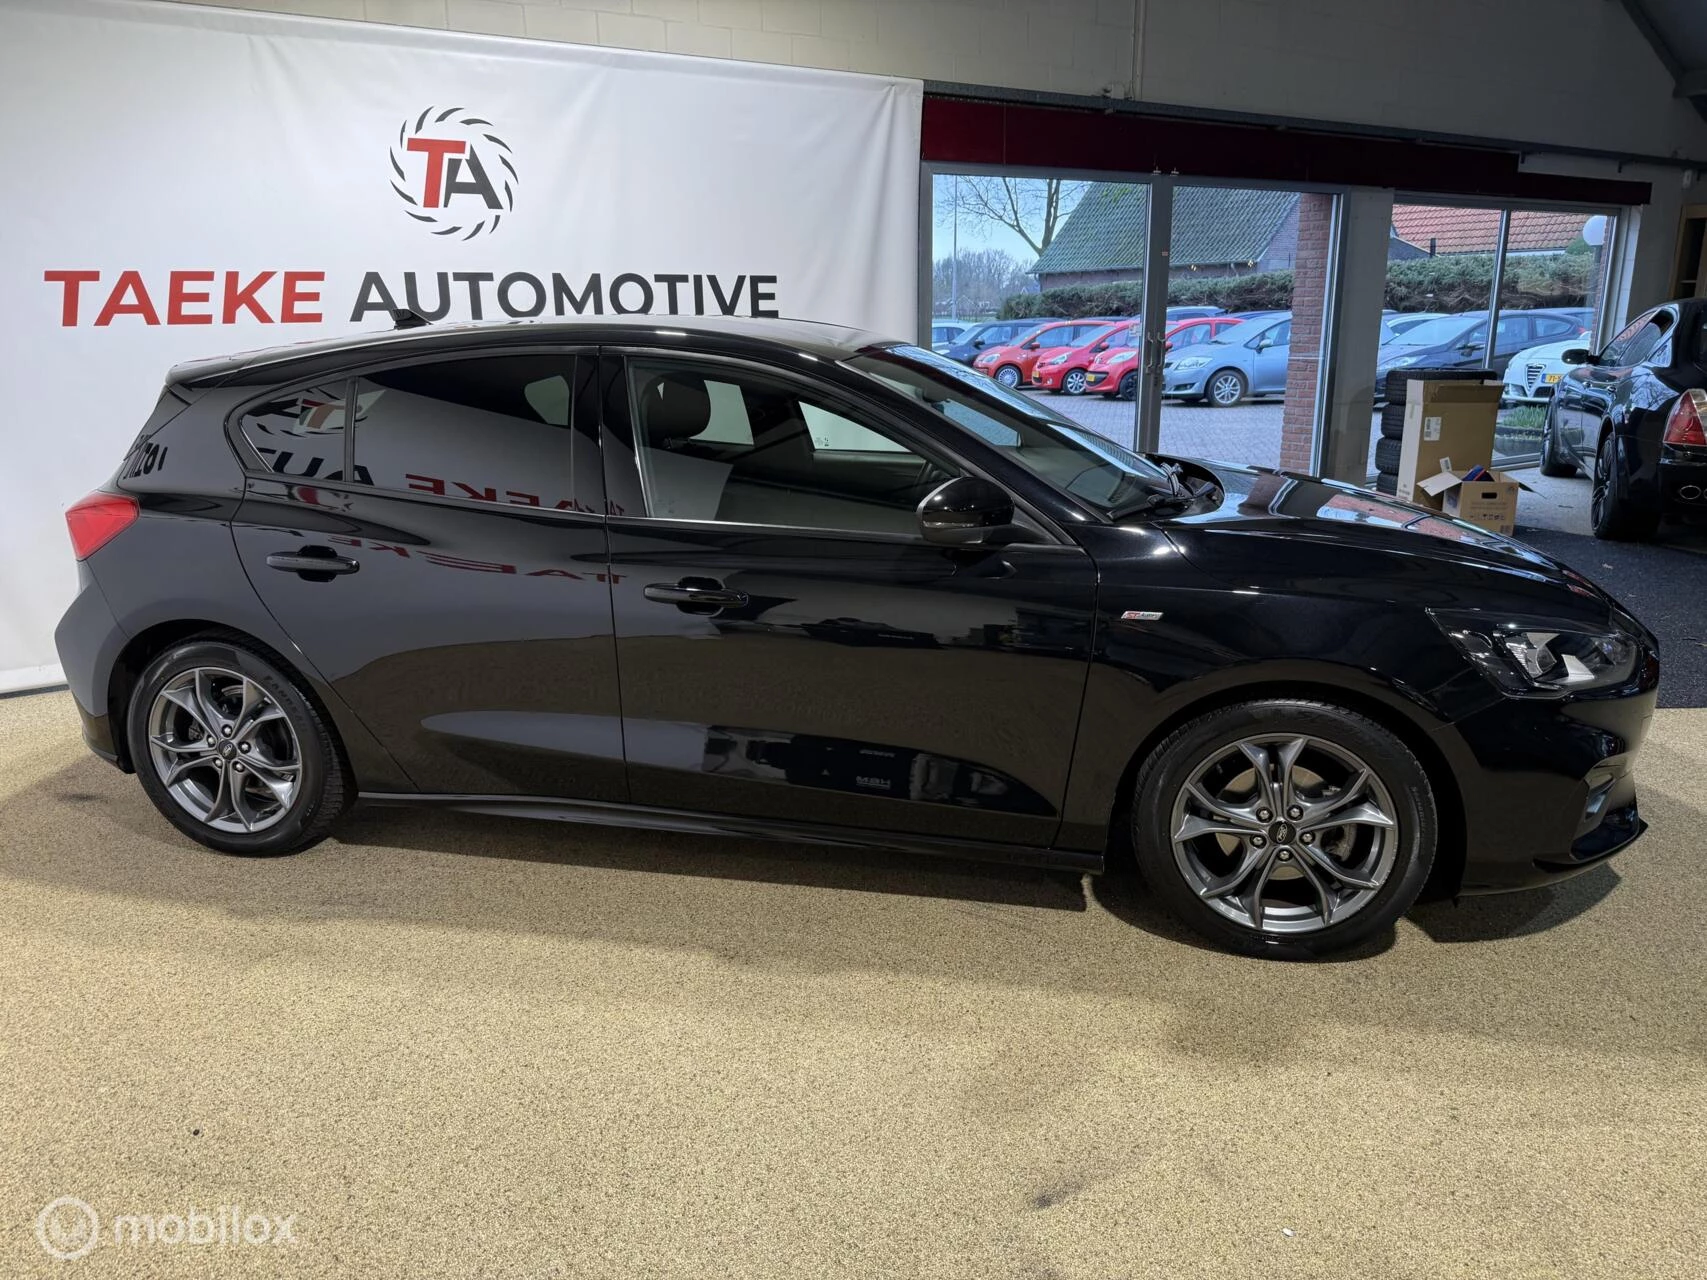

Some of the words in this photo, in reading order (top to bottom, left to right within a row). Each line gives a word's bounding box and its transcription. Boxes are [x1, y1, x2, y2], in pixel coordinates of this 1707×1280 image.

[406, 137, 504, 210] TA
[44, 270, 325, 327] TAEKE
[350, 271, 779, 322] AUTOMOTIVE
